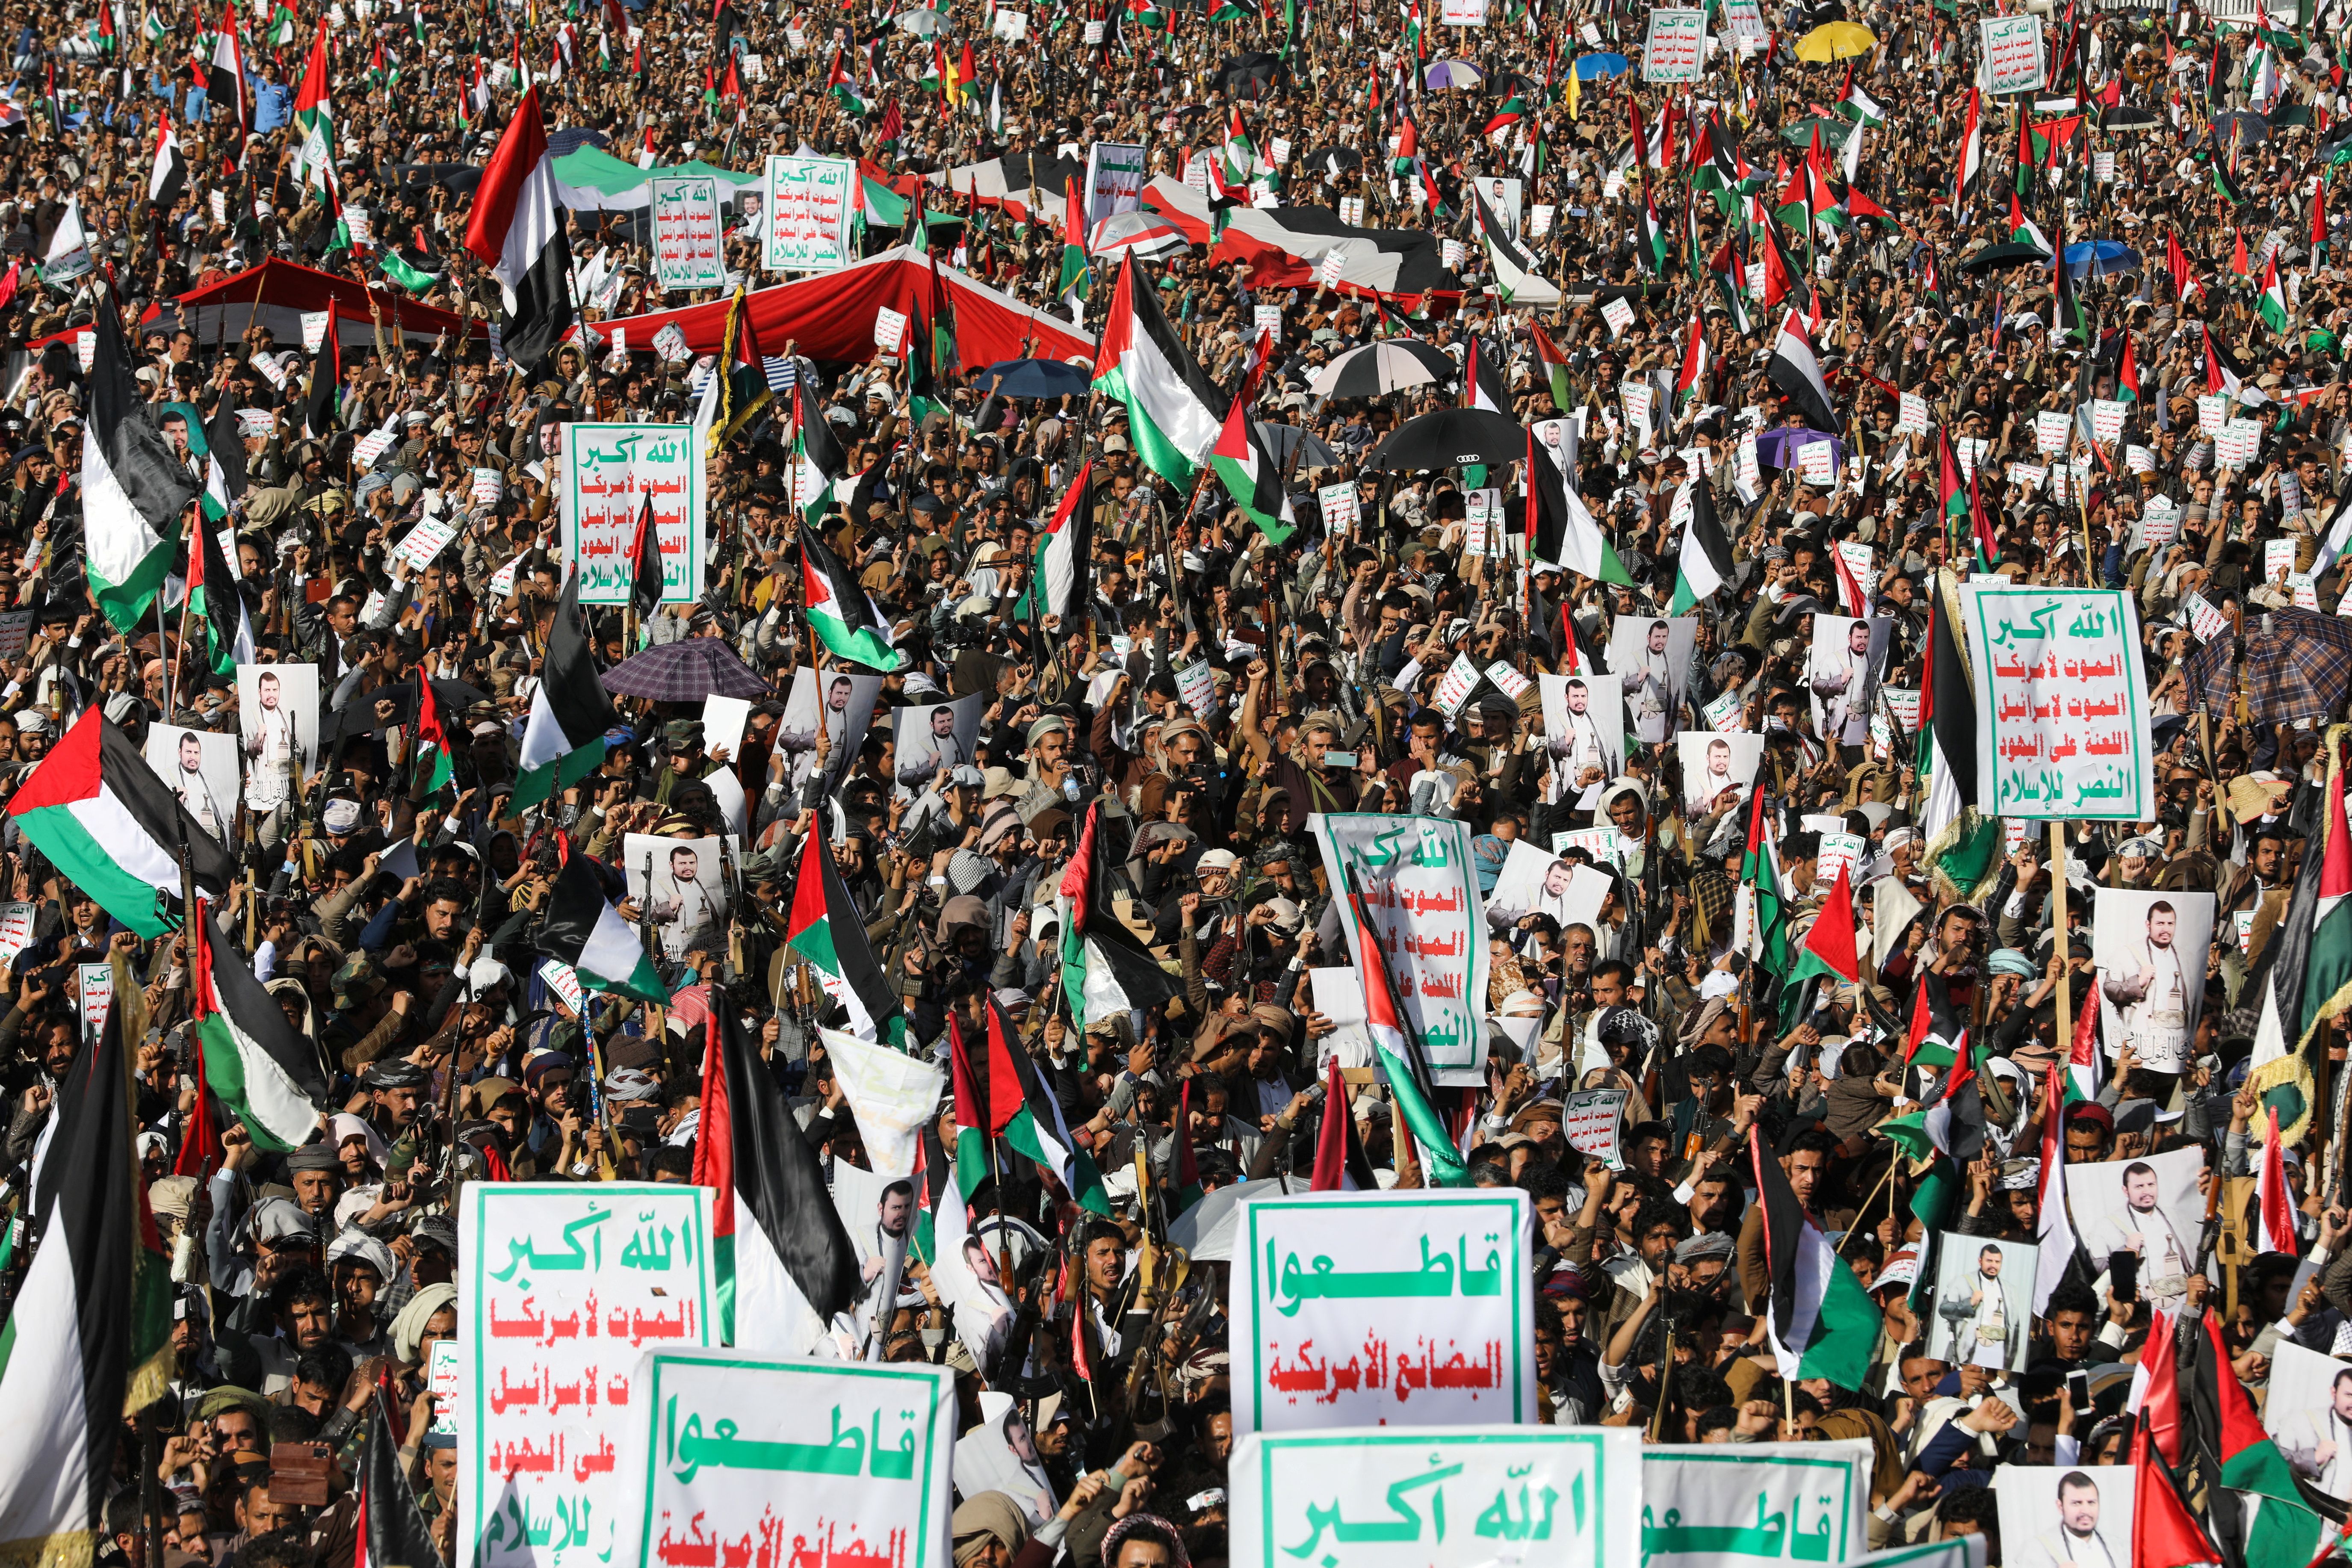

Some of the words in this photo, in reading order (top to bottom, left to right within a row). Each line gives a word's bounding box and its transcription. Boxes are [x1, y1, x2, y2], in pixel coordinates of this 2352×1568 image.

[1655, 15, 1683, 31] أكبر
[1683, 17, 1700, 28] الله
[1990, 21, 2015, 41] أكبر
[2016, 21, 2033, 33] الله
[1654, 30, 1677, 41] لأمريكا
[1679, 33, 1698, 41] الموت
[2016, 36, 2034, 48] الموت
[1652, 44, 1676, 53] لإسرائيل
[1677, 45, 1697, 53] الموت
[1992, 39, 2014, 51] لأمريكا
[1651, 56, 1668, 65] اليهود
[1669, 57, 1678, 65] على
[1681, 56, 1696, 65] اللعنة
[1993, 53, 2015, 65] لإسرائيل
[2017, 50, 2035, 61] الموت
[1650, 66, 1672, 80] للإسلام
[1675, 67, 1694, 80] النصر
[1994, 66, 2009, 78] اليهود
[2012, 65, 2021, 75] على
[2023, 62, 2036, 71] اللعنة
[1994, 77, 2016, 90] للإسلام
[2018, 73, 2036, 87] النصر
[776, 163, 818, 186] أكبر
[818, 168, 844, 185] الله
[657, 182, 690, 207] أكبر
[692, 184, 713, 201] الله
[776, 187, 810, 203] لأمريكا
[813, 193, 841, 206] الموت
[657, 207, 686, 223] لأمريكا
[689, 209, 714, 223] الموت
[775, 207, 810, 222] لإسرائيل
[813, 212, 840, 224] الموت
[659, 228, 688, 243] لإسرائيل
[691, 228, 715, 242] الموت
[774, 226, 800, 239] اليهود
[803, 228, 816, 241] على
[820, 226, 839, 241] اللعنة
[661, 247, 682, 262] اليهود
[685, 246, 695, 261] على
[698, 246, 716, 258] اللعنة
[774, 243, 809, 263] للإسلام
[811, 243, 841, 263] النصر
[664, 265, 691, 284] للإسلام
[696, 263, 720, 283] النصر
[579, 431, 644, 472] أكبر
[646, 435, 688, 463] الله
[580, 470, 635, 498] لأمريكا
[639, 474, 686, 498] الموت
[581, 504, 635, 529] لإسرائيل
[581, 534, 619, 559] اليهود
[659, 534, 686, 555] اللعن
[1990, 598, 2062, 650] أكبر
[2068, 602, 2119, 638] الله
[1198, 664, 1207, 676] الله
[1994, 649, 2059, 684] لأمريكا
[2064, 652, 2122, 683] الموت
[1181, 669, 1195, 687] أكبر
[1998, 692, 2062, 725] لإسرائيل
[2067, 691, 2126, 723] الموت
[1999, 732, 2044, 763] اليهود
[2049, 730, 2077, 763] على
[2084, 729, 2130, 756] اللعنة
[2001, 768, 2064, 811] للإسلام
[2071, 763, 2130, 808] النصر
[1410, 826, 1459, 868] الله
[1822, 835, 1844, 850] أكبر
[1844, 839, 1859, 850] الله
[1400, 885, 1465, 918] الموت
[1404, 928, 1465, 961] الموت
[84, 967, 112, 986] أكبر
[1421, 969, 1462, 1000] اللعنة
[86, 985, 110, 997] لأمريكا
[1419, 1007, 1468, 1046] النص
[1569, 1092, 1602, 1112] أكبر
[1601, 1095, 1622, 1105] الله
[1569, 1109, 1593, 1123] لأمريكا
[1595, 1109, 1617, 1120] الموت
[1570, 1125, 1592, 1140] لإسرائيل
[1594, 1123, 1614, 1135] الموت
[1588, 1140, 1597, 1152] على
[1599, 1137, 1613, 1147] اللعنة
[488, 1201, 612, 1291] أكبر
[620, 1209, 692, 1272] الله
[1266, 1232, 1501, 1318] قاطعوا
[490, 1288, 599, 1349] لأمريكا
[607, 1297, 695, 1349] الموت
[1268, 1326, 1388, 1406] الأمريكية
[1395, 1334, 1502, 1404] البضائع
[490, 1361, 599, 1417] لإسرائيل
[667, 1392, 916, 1485] قاطعوا
[489, 1430, 565, 1484] اليهود
[573, 1430, 616, 1483] على
[1474, 1461, 1584, 1541] الله
[1281, 1452, 1464, 1568] أكبر
[485, 1493, 592, 1568] للإسلام
[1643, 1490, 1831, 1568] قاطعو
